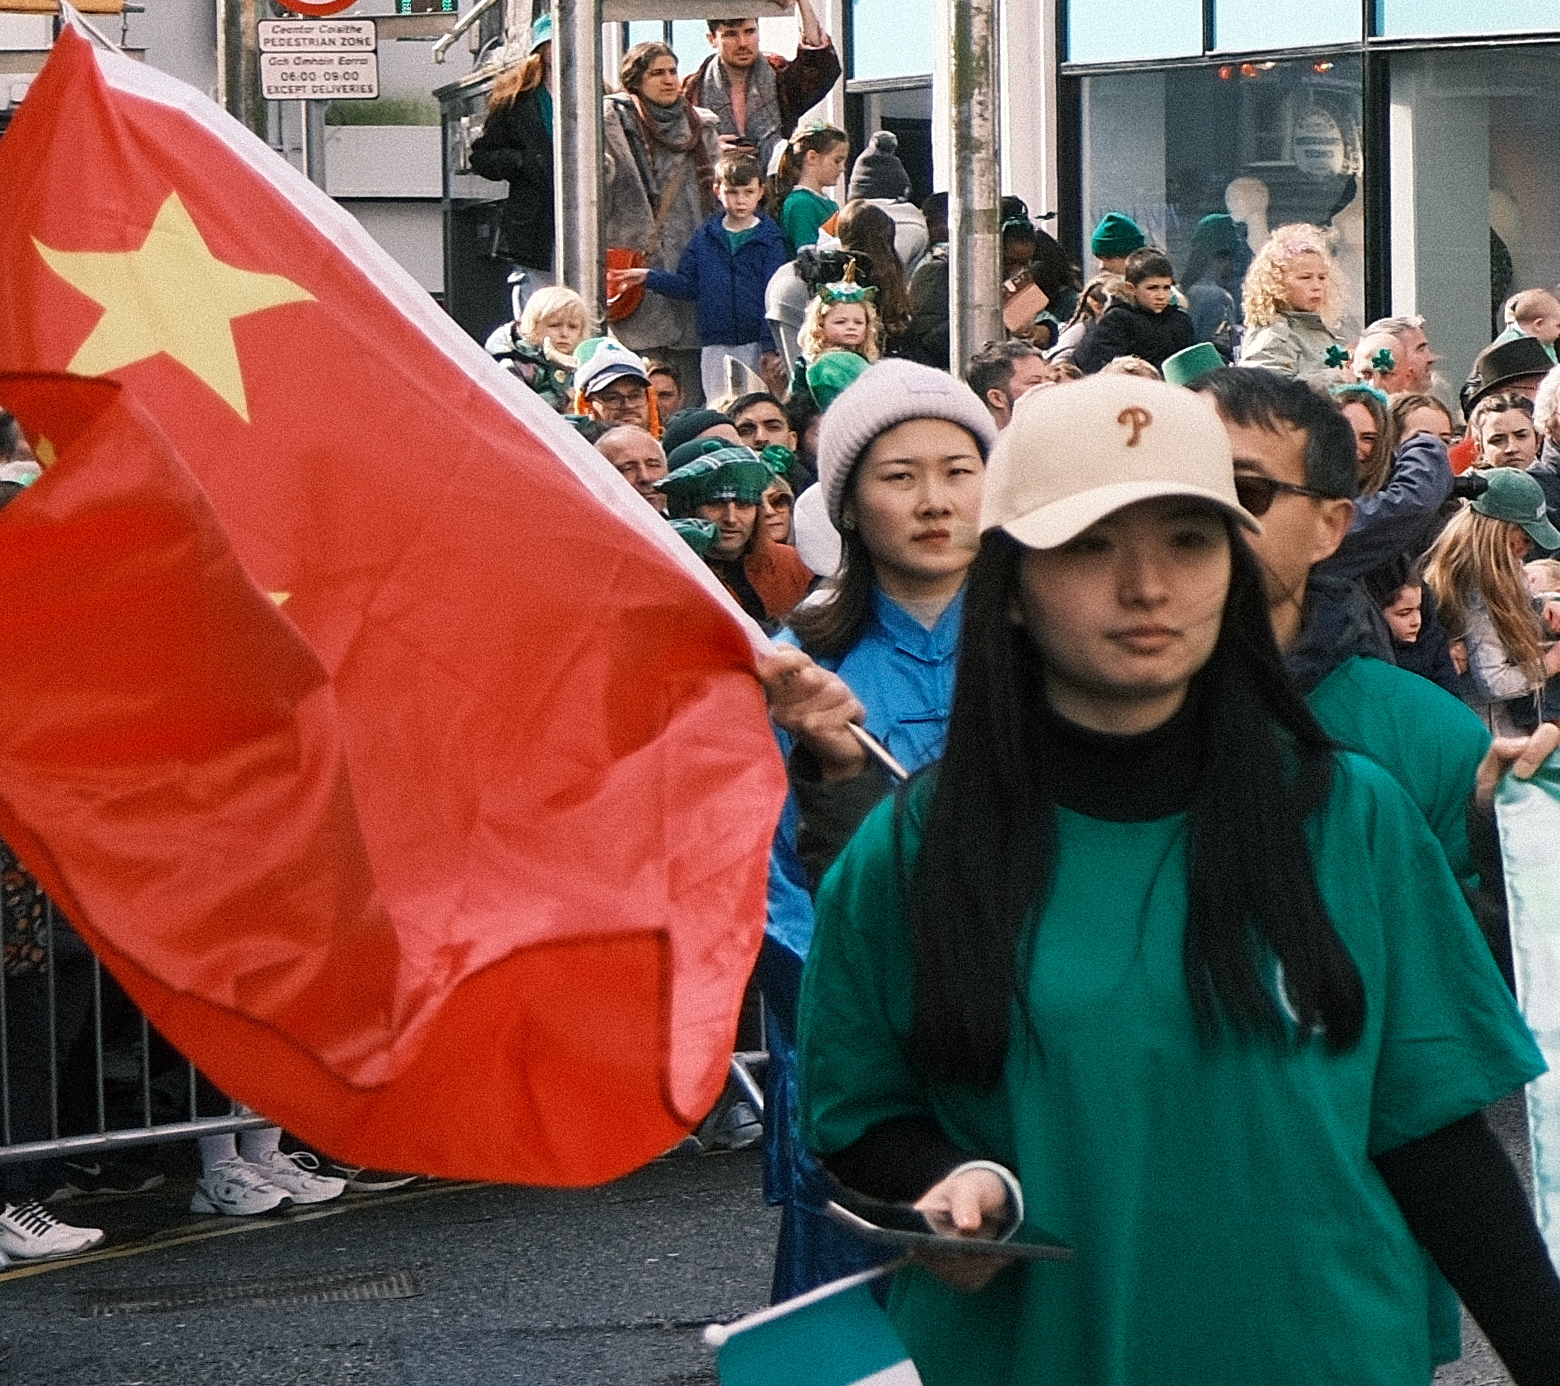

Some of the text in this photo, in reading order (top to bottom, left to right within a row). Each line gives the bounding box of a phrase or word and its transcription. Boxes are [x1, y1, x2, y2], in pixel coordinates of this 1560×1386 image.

[263, 37, 372, 47] PEDESTRIAN ZONE
[266, 84, 373, 94] EXCEPT DELIVERIES
[1116, 405, 1153, 448] P
